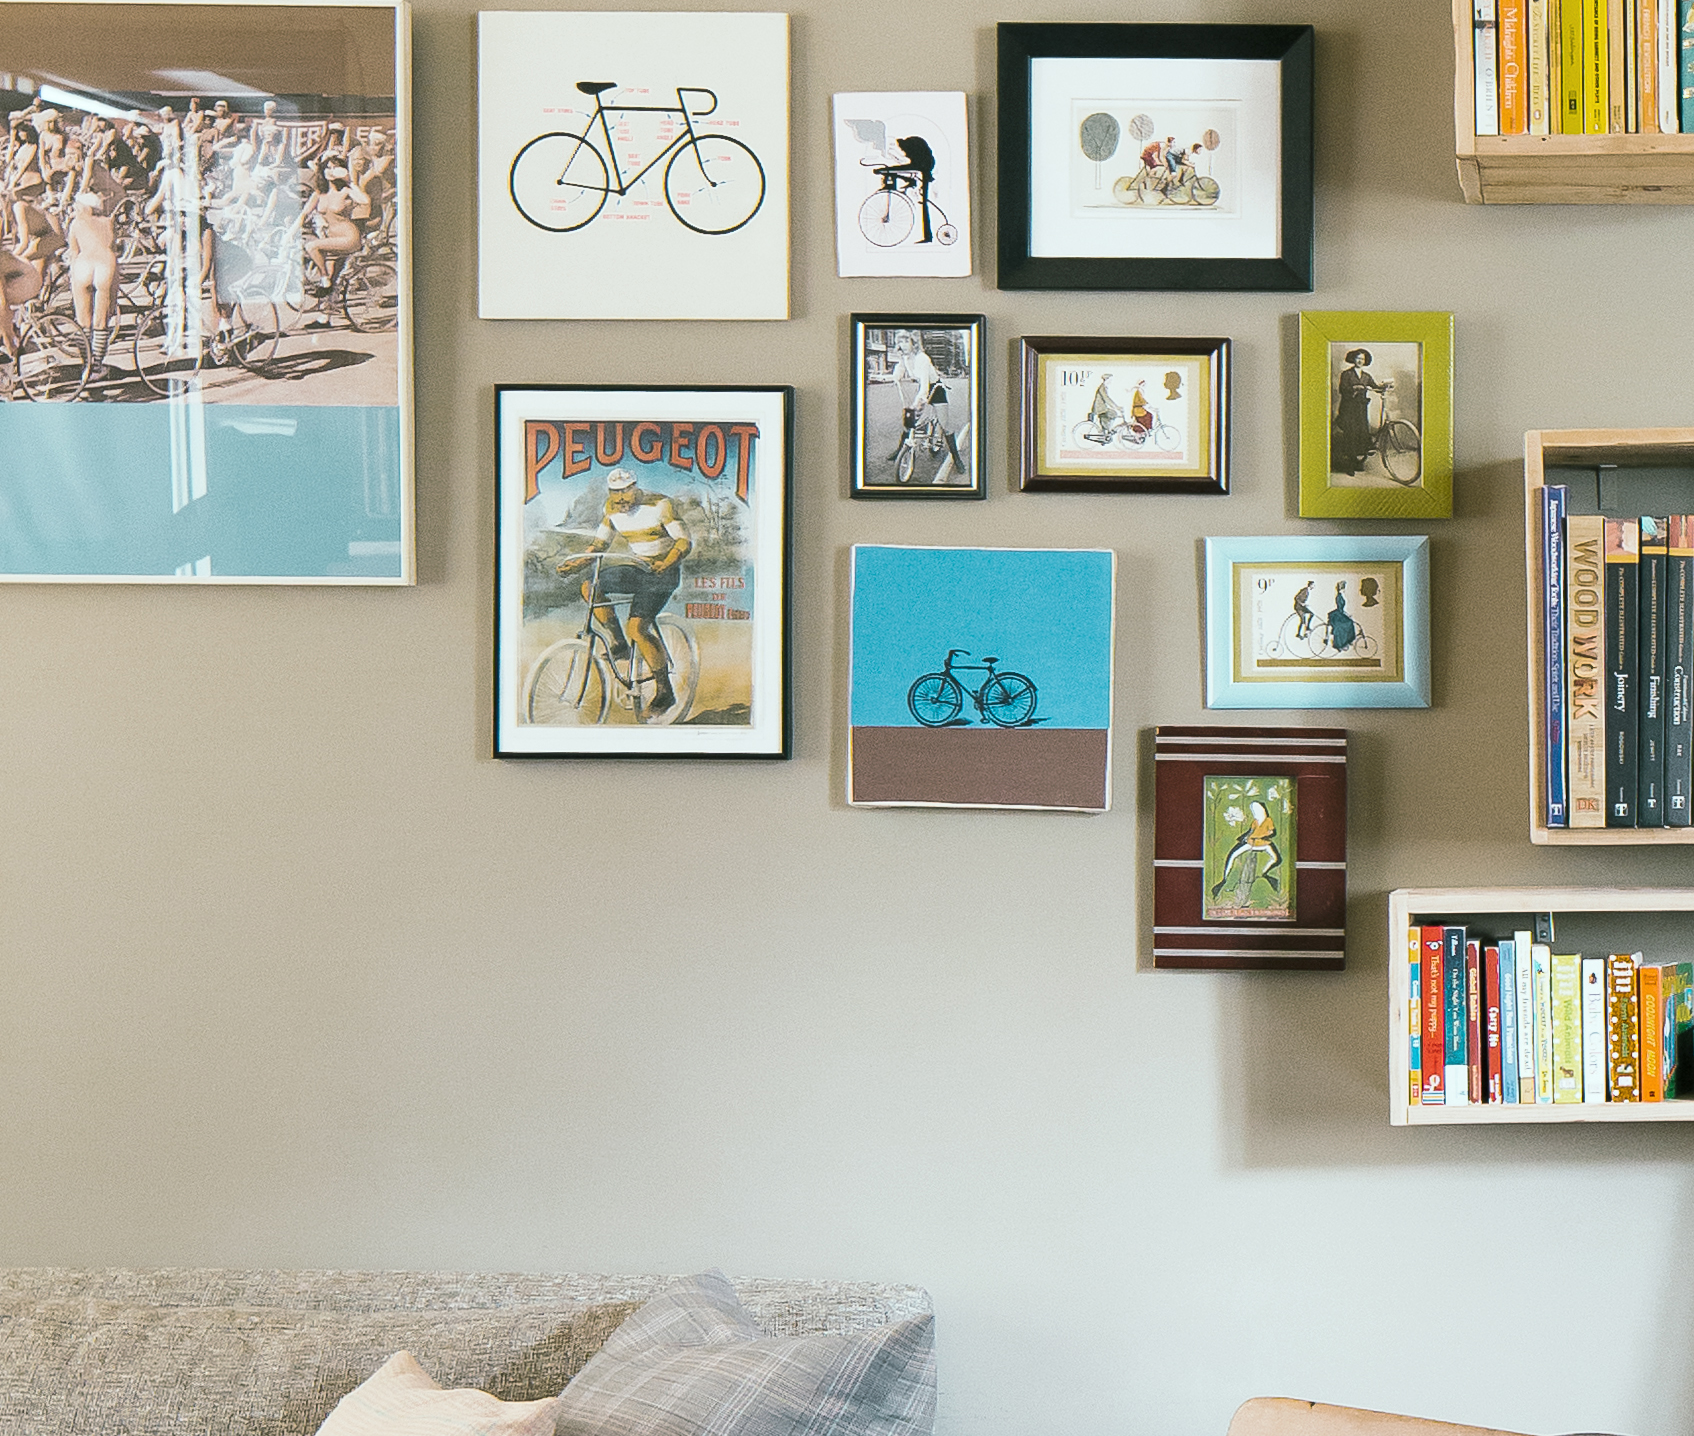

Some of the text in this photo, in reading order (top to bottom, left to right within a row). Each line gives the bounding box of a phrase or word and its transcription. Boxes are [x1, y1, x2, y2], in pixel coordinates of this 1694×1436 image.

[1504, 62, 1519, 108] Children
[524, 421, 760, 506] PEUGEOT
[694, 576, 745, 589] LES FILS
[1613, 672, 1628, 712] Joinery
[1646, 675, 1660, 718] Finishing
[1672, 665, 1684, 725] Construction
[1430, 955, 1439, 978] That's
[1430, 979, 1438, 992] not
[1427, 995, 1438, 1007] my
[1563, 1000, 1574, 1063] Wild Animals
[1645, 994, 1656, 1077] GOODNIGHT MOON
[1589, 1032, 1602, 1074] Colors
